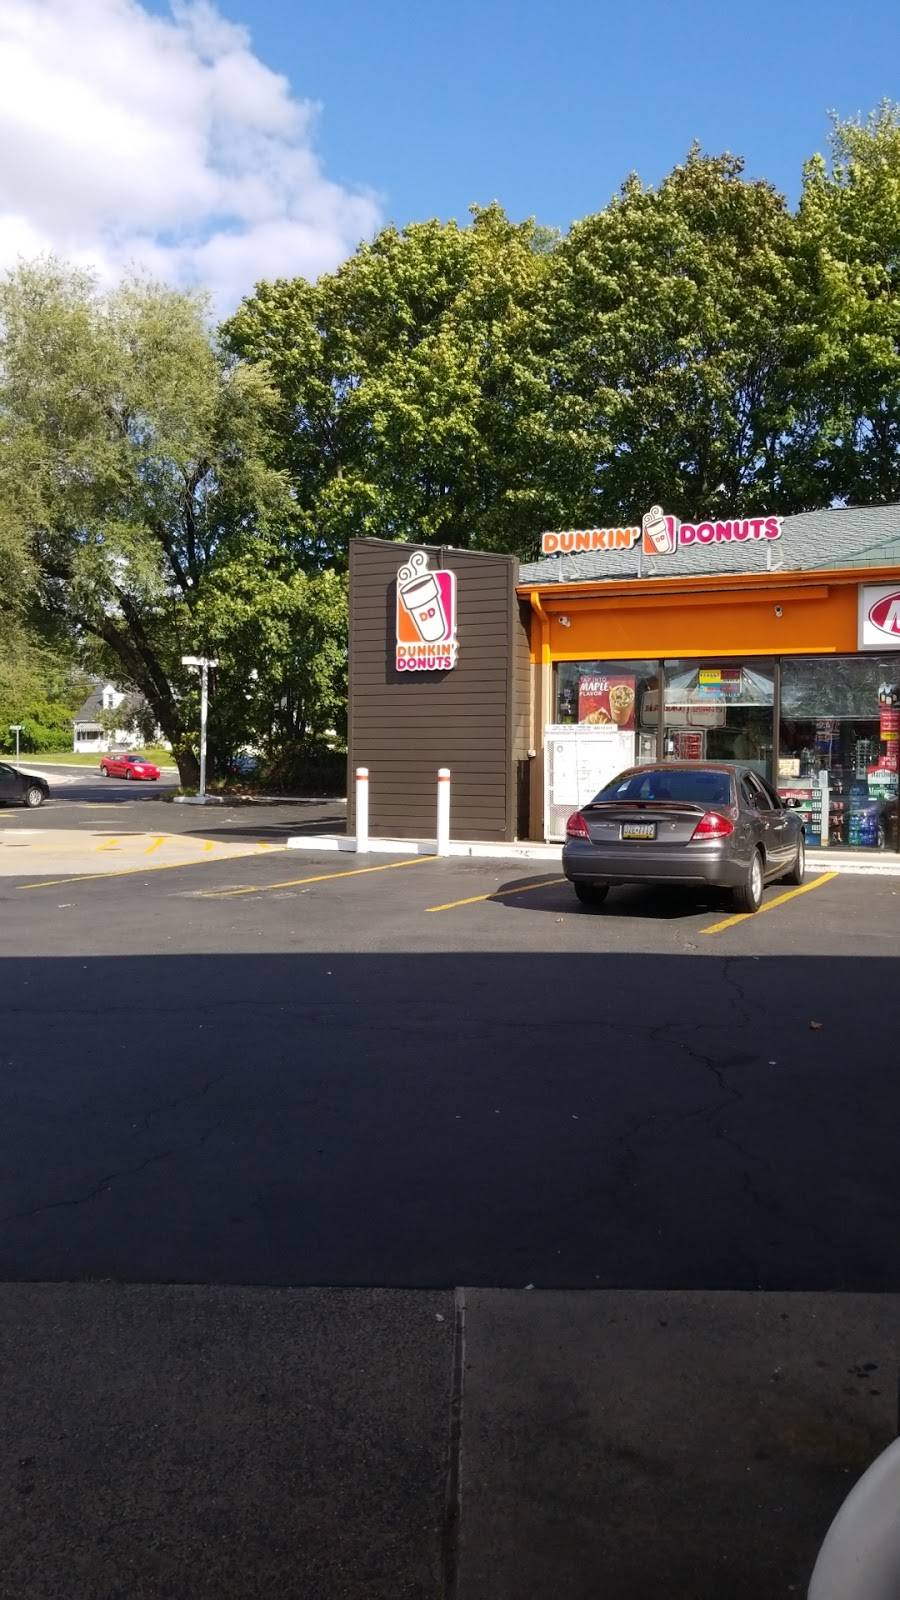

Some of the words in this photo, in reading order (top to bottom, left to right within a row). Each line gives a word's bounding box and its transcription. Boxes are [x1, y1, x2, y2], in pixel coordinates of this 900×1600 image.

[543, 529, 638, 553] DUNKIN'
[680, 518, 779, 544] DONUTS
[419, 608, 436, 622] DD
[398, 644, 454, 657] DUNKIN'
[398, 656, 451, 669] DONUTS
[579, 682, 609, 692] MAPLE
